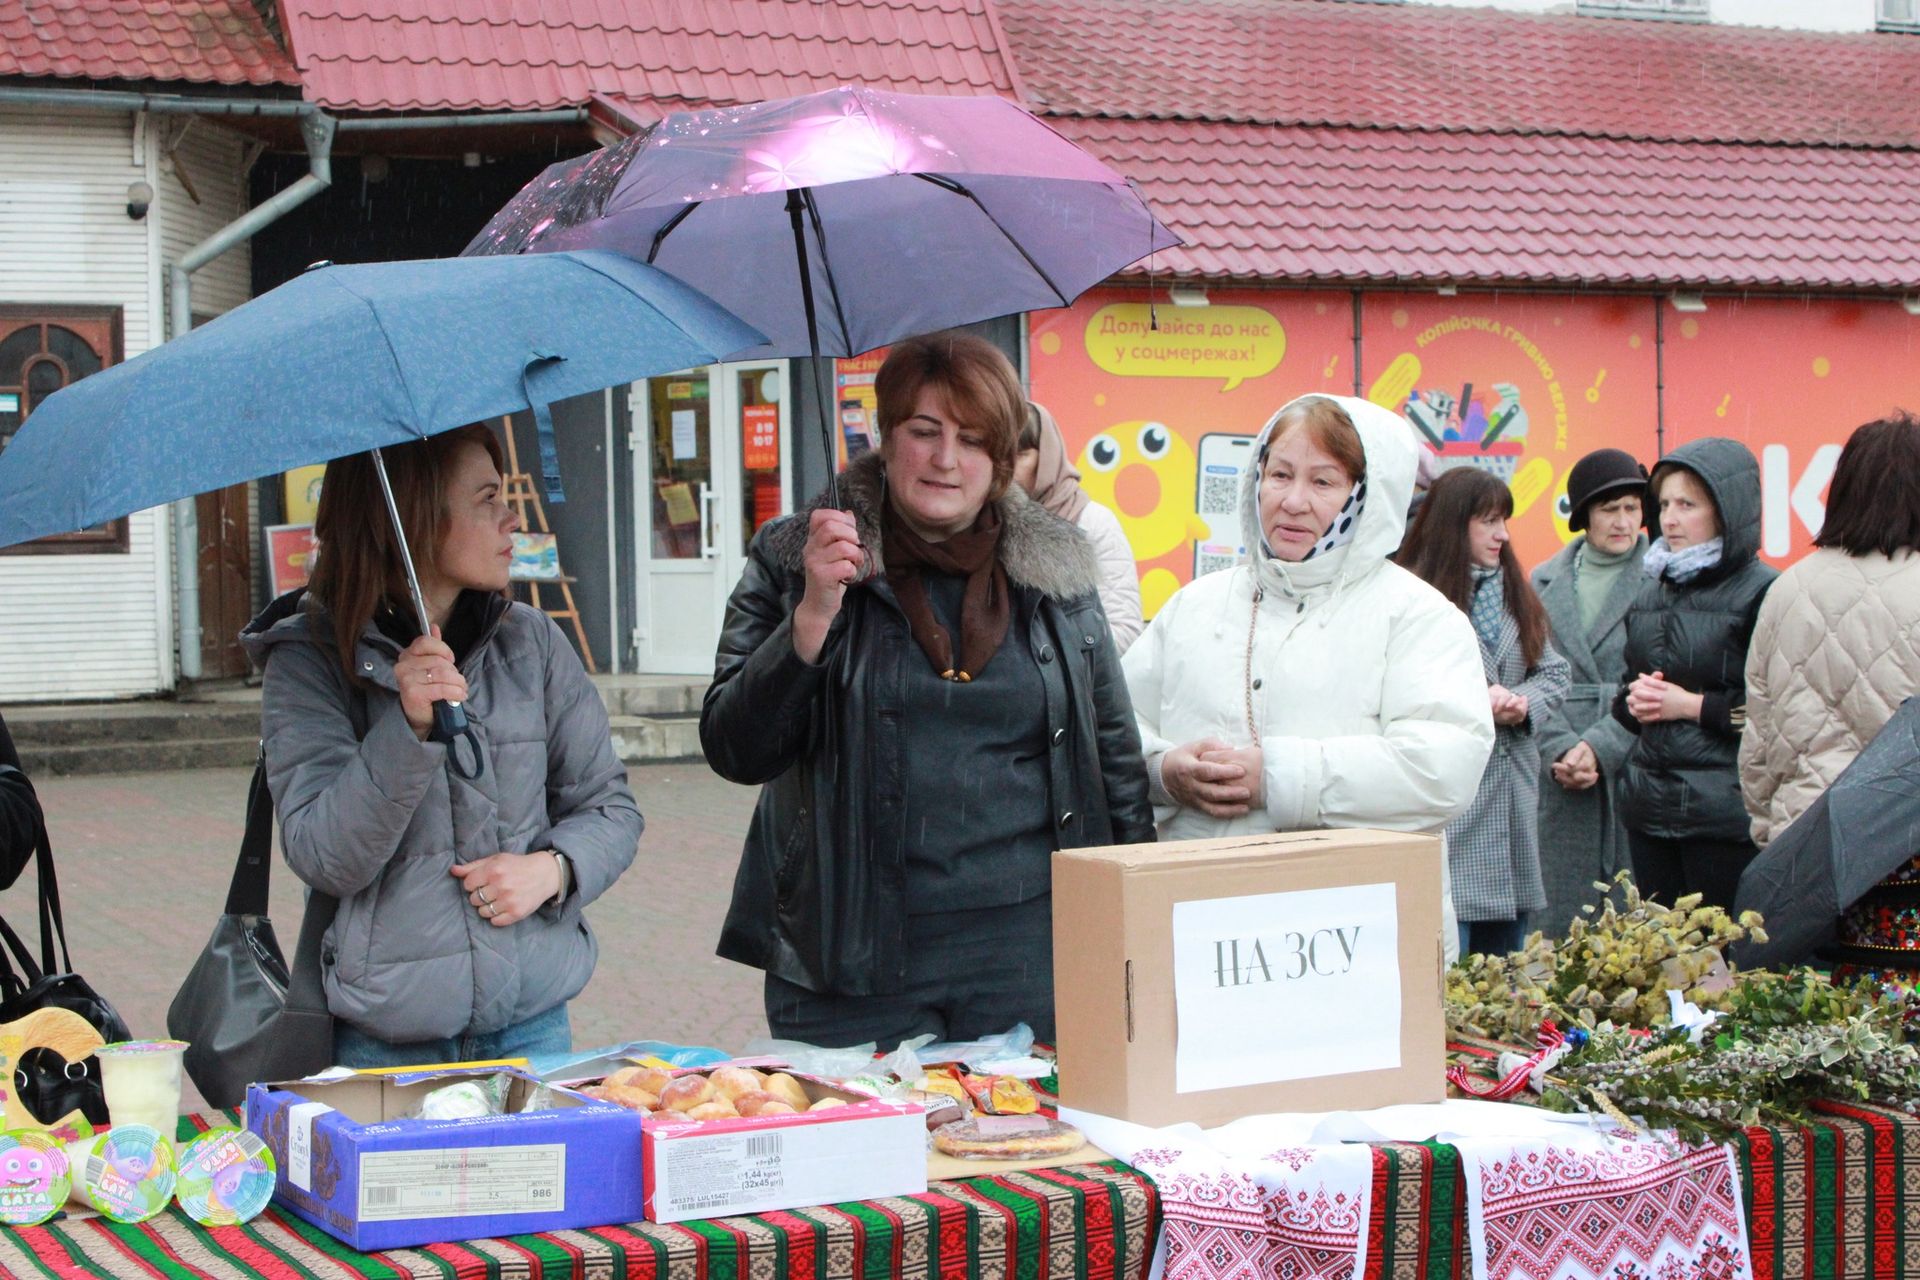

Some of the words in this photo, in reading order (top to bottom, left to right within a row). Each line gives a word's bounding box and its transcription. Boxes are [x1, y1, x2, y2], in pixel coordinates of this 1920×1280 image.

[1210, 323, 1233, 338] до
[1240, 324, 1270, 337] нас
[1116, 347, 1125, 363] у
[1131, 343, 1256, 365] соцмережах!
[1415, 315, 1501, 348] КОПІЙОЧКА
[1503, 325, 1553, 380] ГРИВНЮ
[1213, 937, 1275, 988] НА
[1285, 926, 1363, 980] ЗСУ
[532, 1189, 552, 1198] 986
